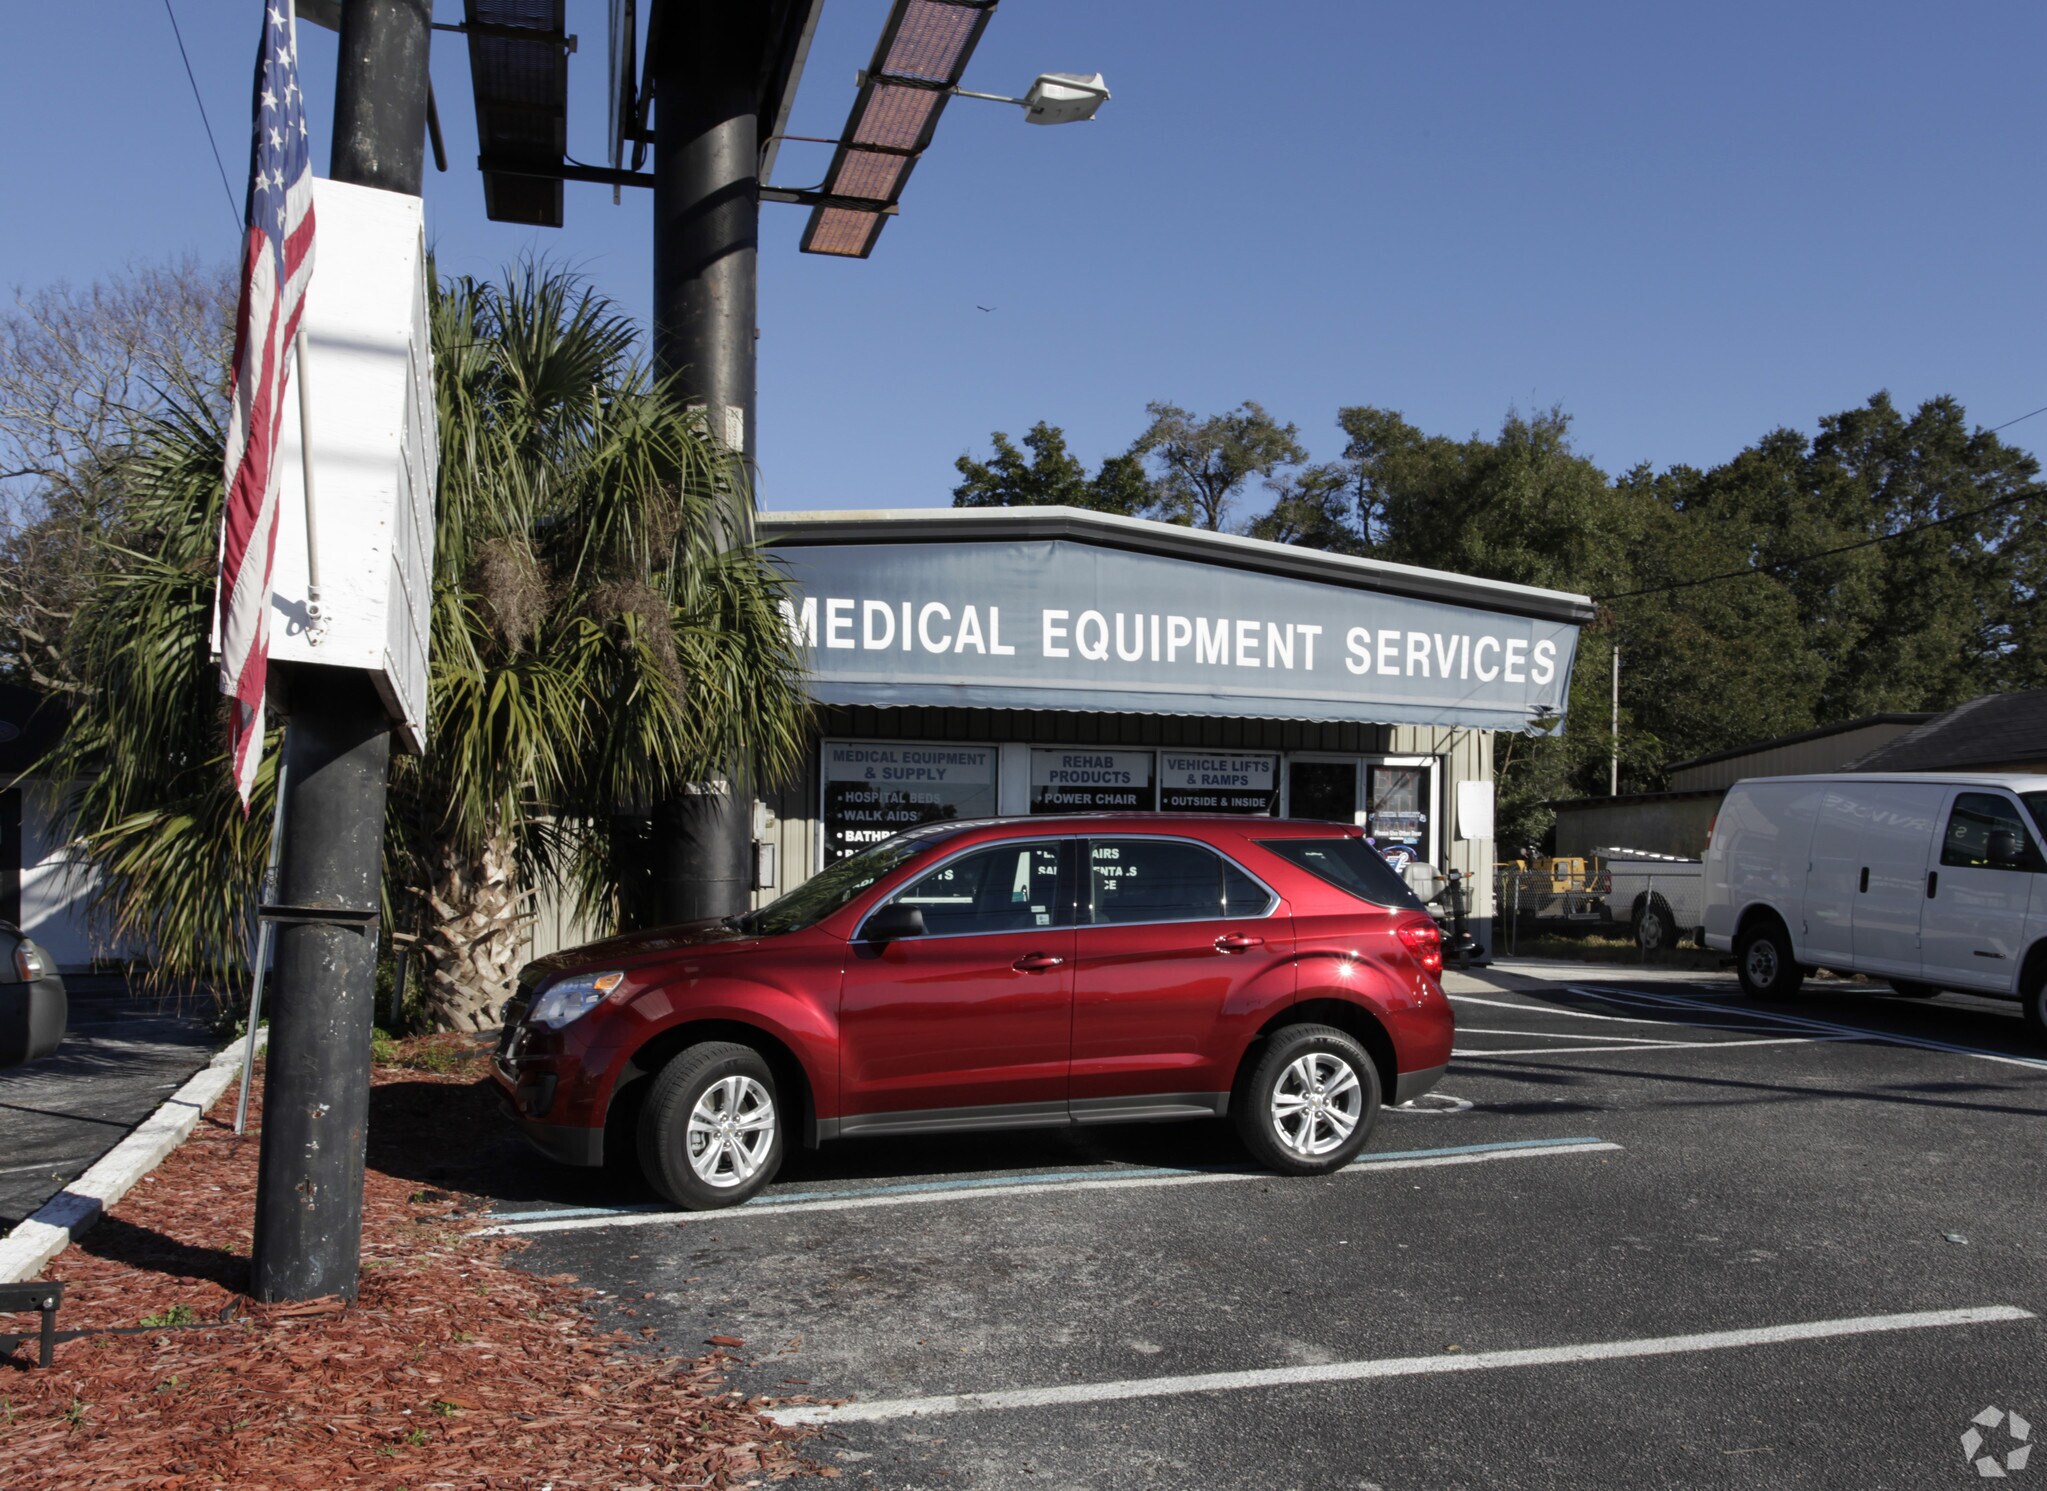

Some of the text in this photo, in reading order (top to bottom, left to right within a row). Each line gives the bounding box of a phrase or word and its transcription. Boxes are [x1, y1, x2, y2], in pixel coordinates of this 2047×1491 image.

[778, 596, 1557, 686] MEDICAL EQUIPMENT SERVICES
[833, 749, 986, 766] MEDICAL EQUIPMENT
[1062, 755, 1114, 769] REHAB
[1167, 758, 1270, 773] VEHICLE LIFTS
[864, 766, 947, 781] & SUPPLY
[1049, 770, 1131, 784] PRODUCTS
[1186, 773, 1249, 786] & RAMPS
[845, 791, 941, 804] HOSPITAL BEDS
[1044, 793, 1137, 806] POWER CHAIR
[1171, 796, 1266, 809] OUTSIDE & INSIDE
[844, 810, 918, 822] WALK AIDS
